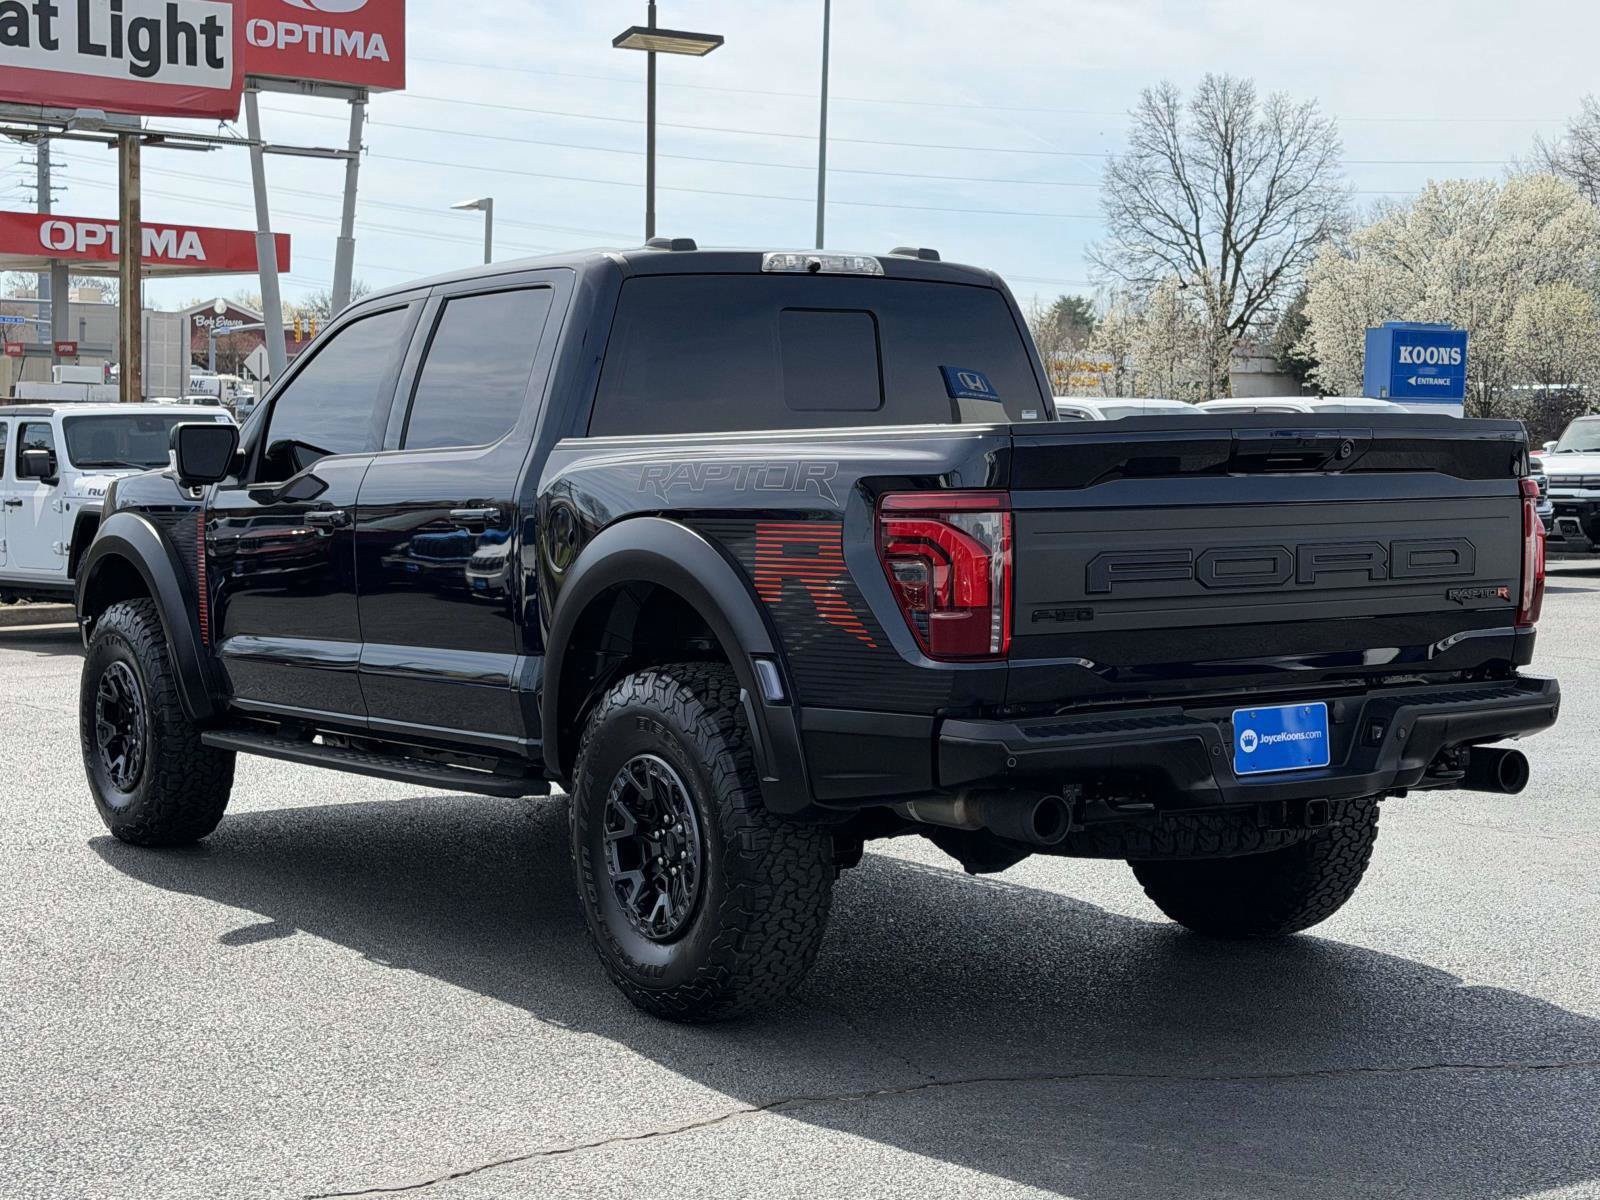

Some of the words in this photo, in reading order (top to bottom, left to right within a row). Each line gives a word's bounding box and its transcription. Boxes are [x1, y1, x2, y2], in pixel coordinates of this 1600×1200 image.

[78, 0, 224, 77] Light
[245, 18, 390, 62] OPTIMA
[40, 220, 207, 260] OPTMA
[193, 315, 215, 327] Bob
[216, 316, 243, 327] Evans
[1399, 346, 1461, 365] KOONS
[1417, 377, 1451, 386] ENTRANCE
[637, 461, 840, 508] RAPTOR
[1085, 536, 1476, 595] FORD
[1446, 585, 1512, 605] RAPTOR
[1259, 730, 1322, 745] JoyceKoons.com
